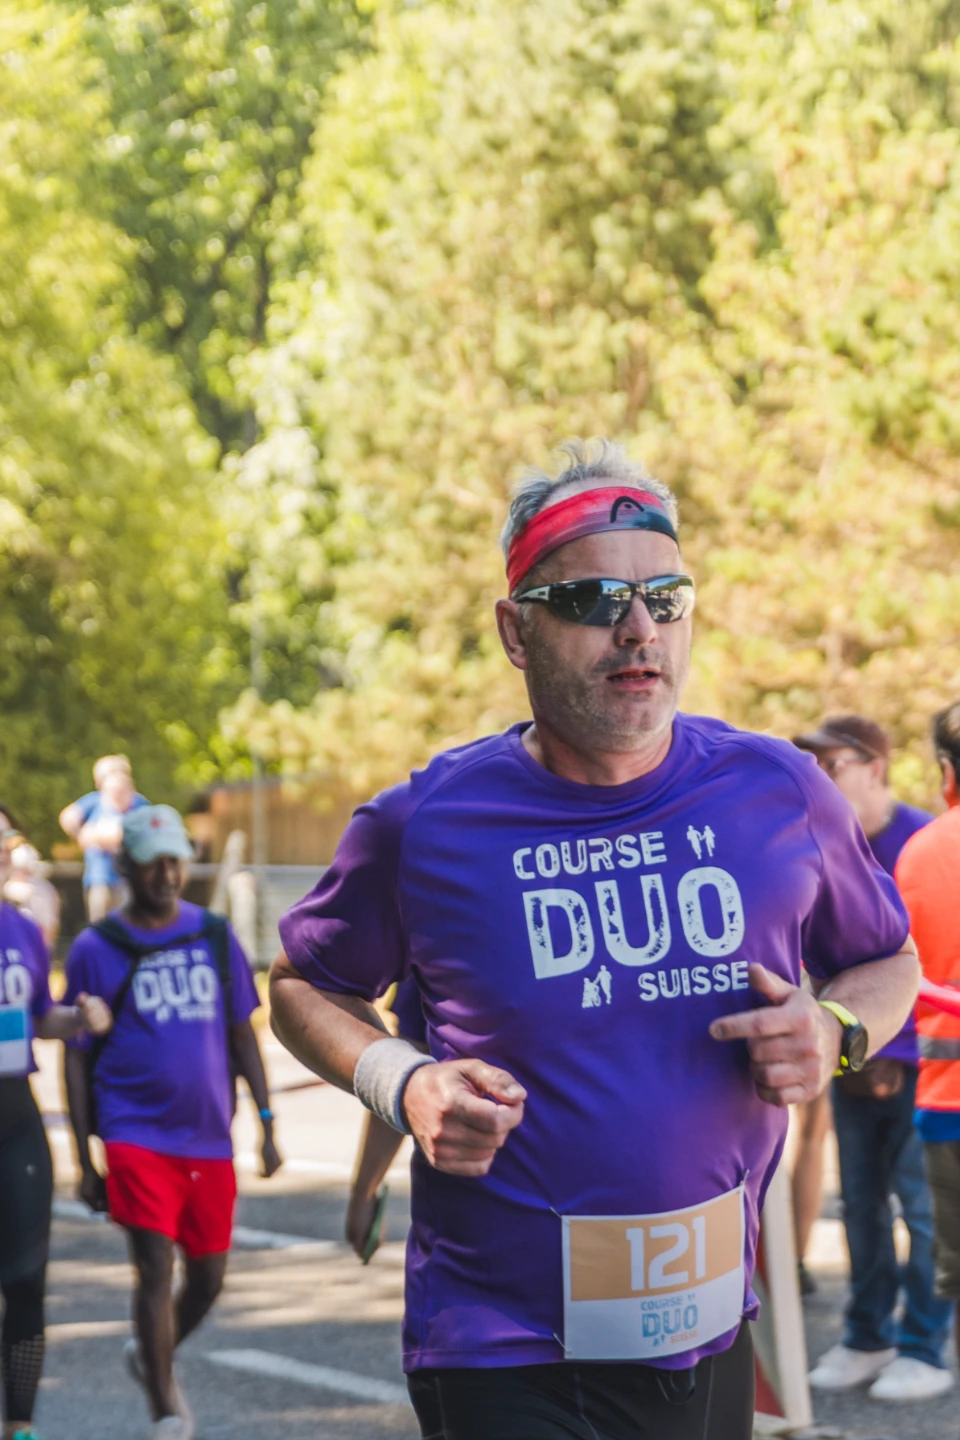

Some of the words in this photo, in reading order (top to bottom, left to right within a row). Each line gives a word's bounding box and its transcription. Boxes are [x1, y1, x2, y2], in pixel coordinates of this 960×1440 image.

[513, 831, 667, 880] COURSE
[522, 866, 745, 980] DUO
[132, 965, 217, 1012] DUO
[638, 961, 749, 1002] SUISSE
[625, 1215, 707, 1291] 121
[641, 1296, 683, 1311] COURSE
[642, 1304, 698, 1338] DUO
